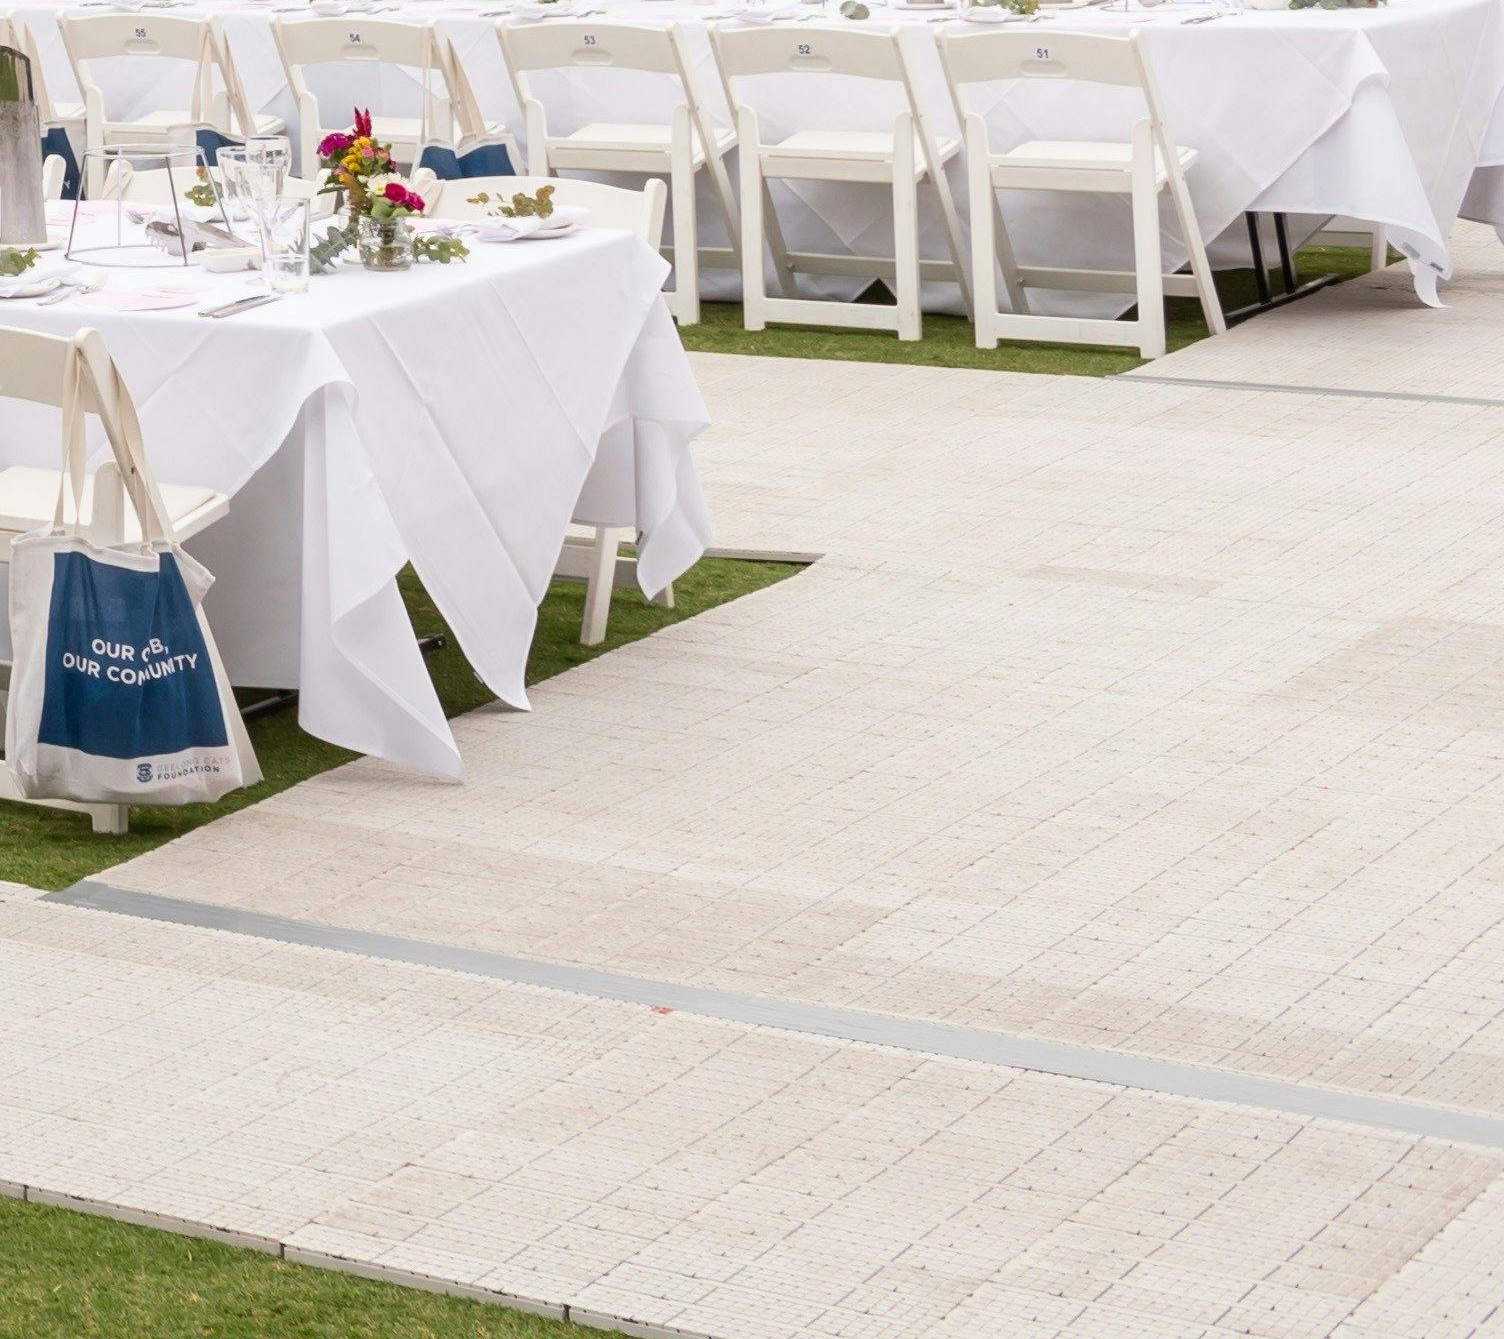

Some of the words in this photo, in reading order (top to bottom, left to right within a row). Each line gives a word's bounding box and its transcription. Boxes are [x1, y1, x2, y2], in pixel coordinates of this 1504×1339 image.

[349, 34, 360, 43] 54
[584, 35, 595, 45] 53
[799, 45, 810, 54] 52
[1037, 49, 1048, 59] 51
[91, 638, 135, 663] OUR
[62, 652, 101, 680] OUR
[106, 653, 199, 687] COMUNITY
[157, 765, 221, 781] FOUNDATION
